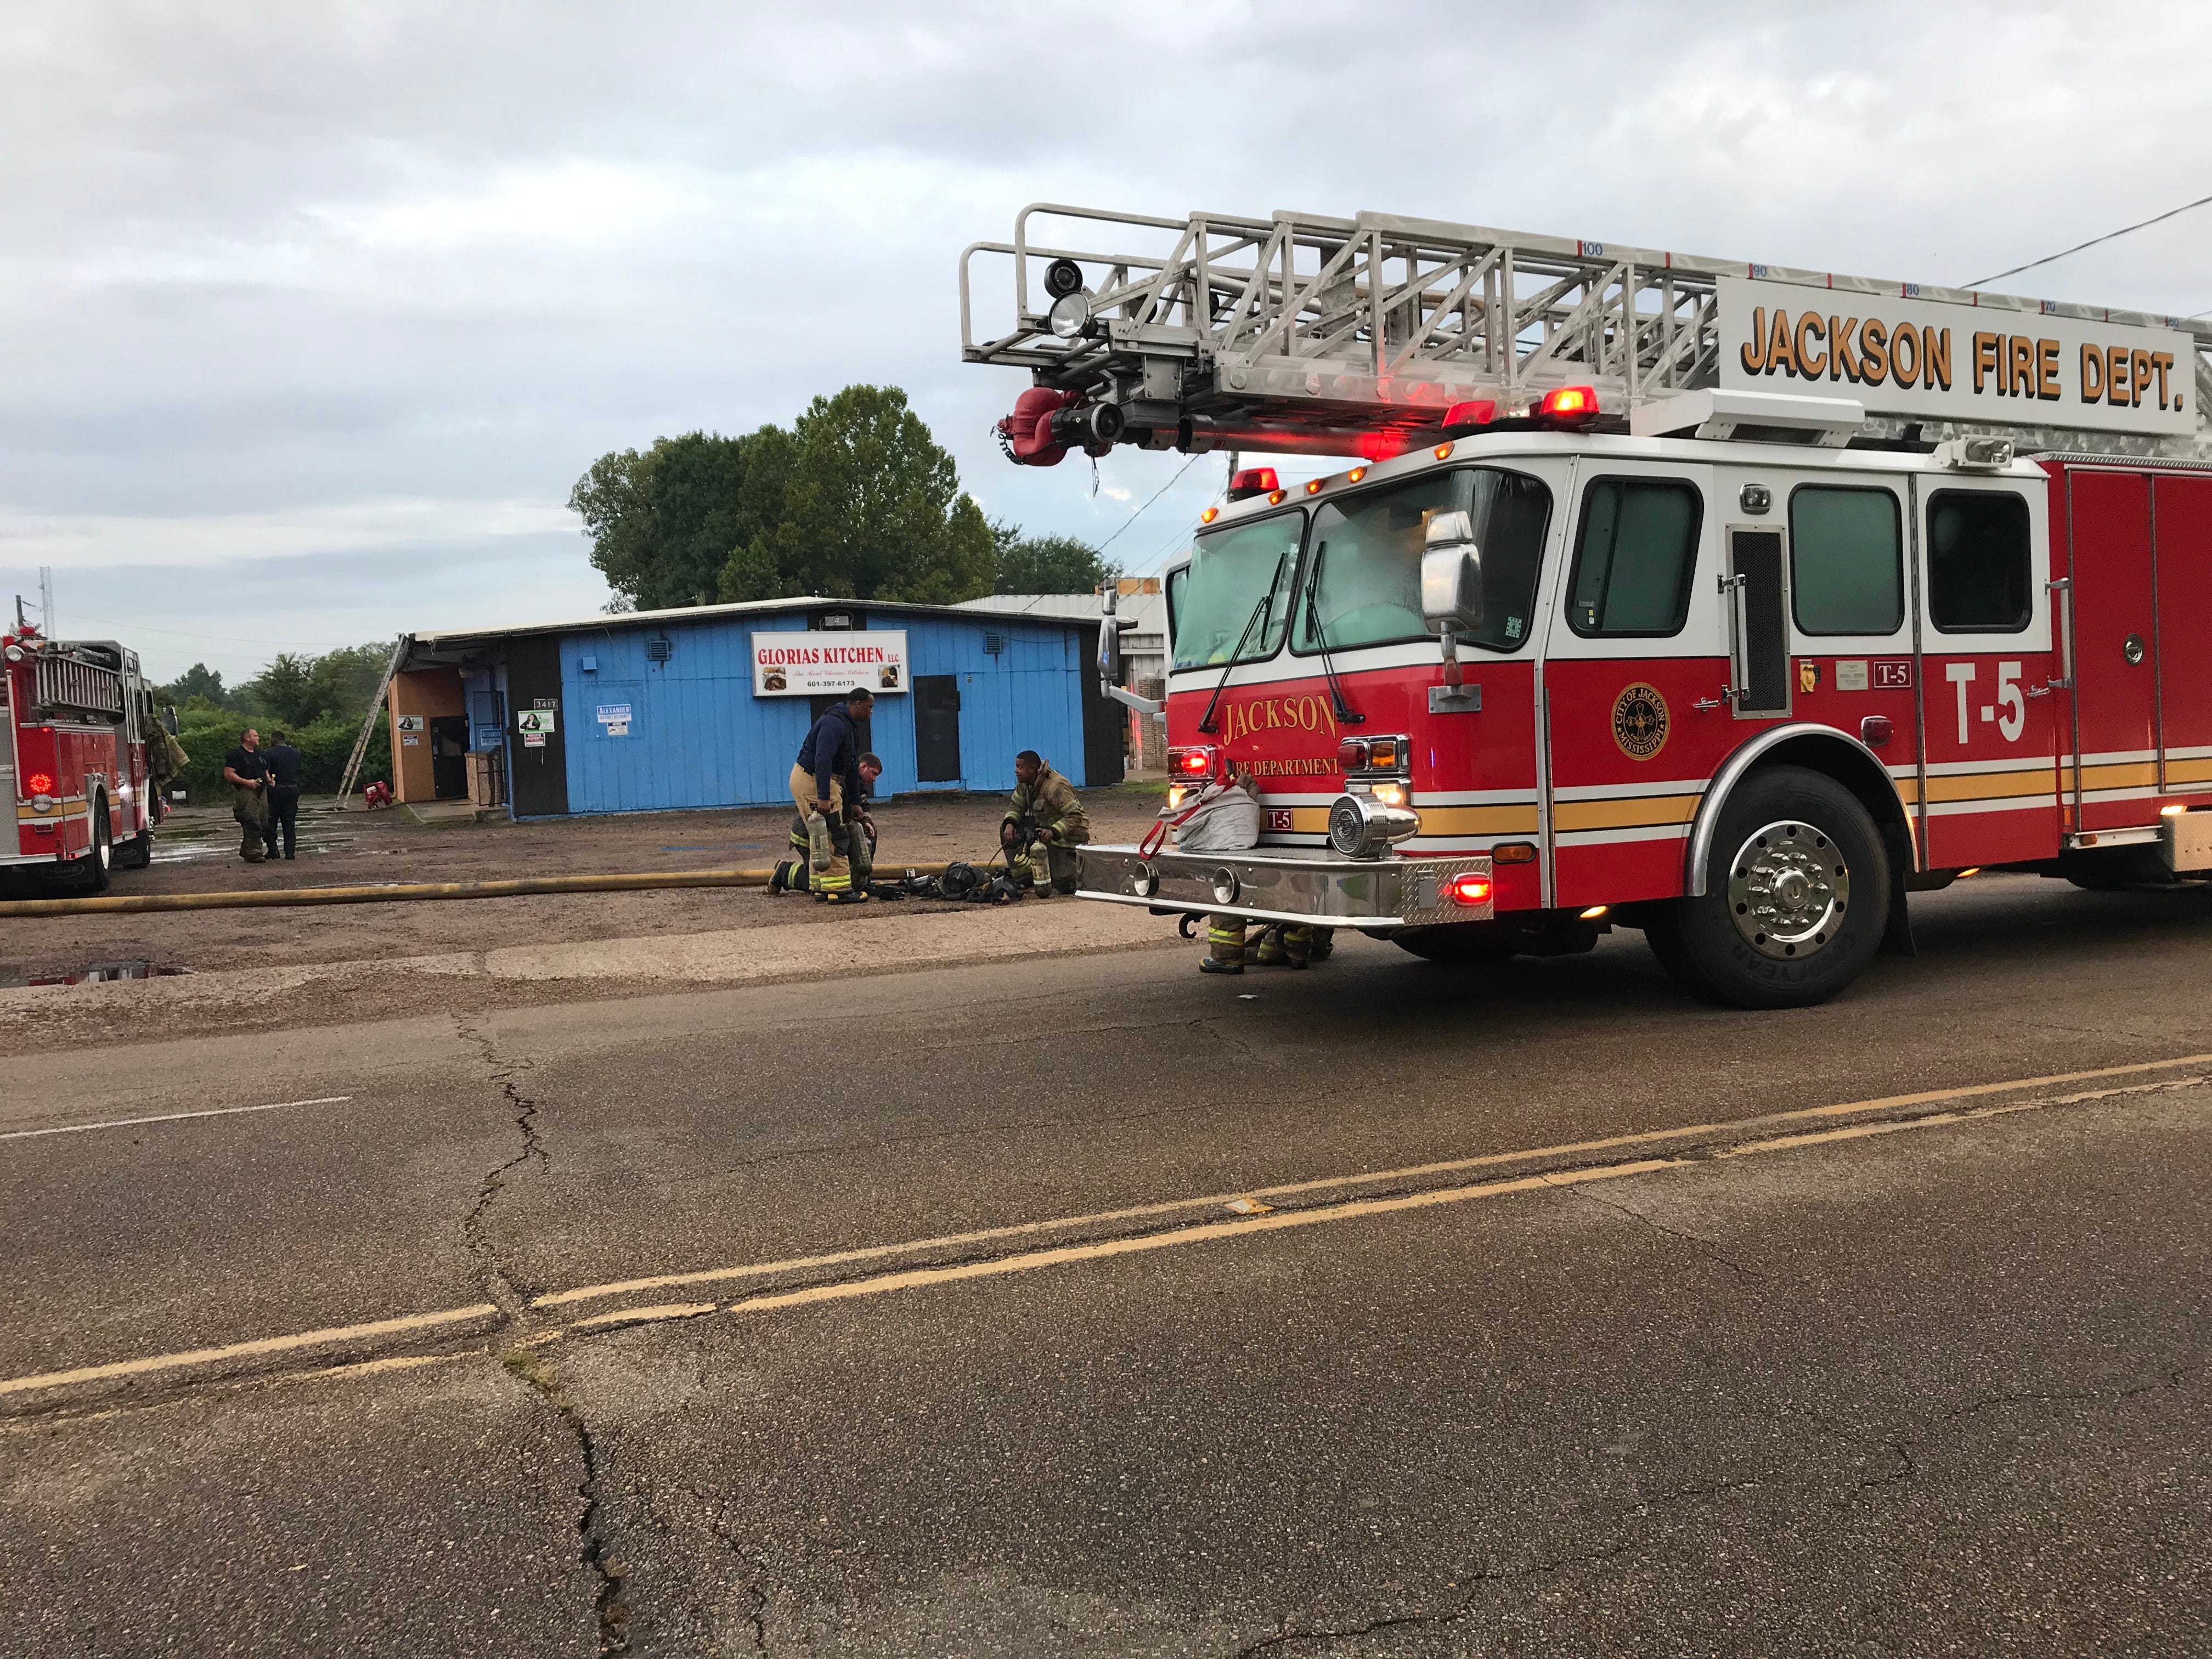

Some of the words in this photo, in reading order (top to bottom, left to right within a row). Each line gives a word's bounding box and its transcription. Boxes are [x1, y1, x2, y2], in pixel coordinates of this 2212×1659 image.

[1583, 241, 1603, 256] 100
[1753, 264, 1767, 277] 90
[1907, 284, 1919, 295] 80
[2045, 301, 2055, 312] 70
[1740, 306, 1952, 391] JACKSON
[1973, 331, 2061, 401] FIRE
[2080, 342, 2183, 412] DEPT.
[758, 648, 820, 665] GLORIAS
[823, 647, 884, 663] KITCHEN
[1878, 665, 1906, 684] T-5
[599, 706, 629, 714] ALEXANDER
[1616, 697, 1628, 724] CITY
[1626, 689, 1637, 702] OF
[1638, 689, 1665, 721] JACKSON
[1945, 661, 2025, 744] T-5
[1223, 695, 1336, 746] JACKSON
[1619, 728, 1664, 754] MISSISSIPPI
[1254, 758, 1339, 776] DEPARTMENT
[1269, 811, 1290, 828] T-5
